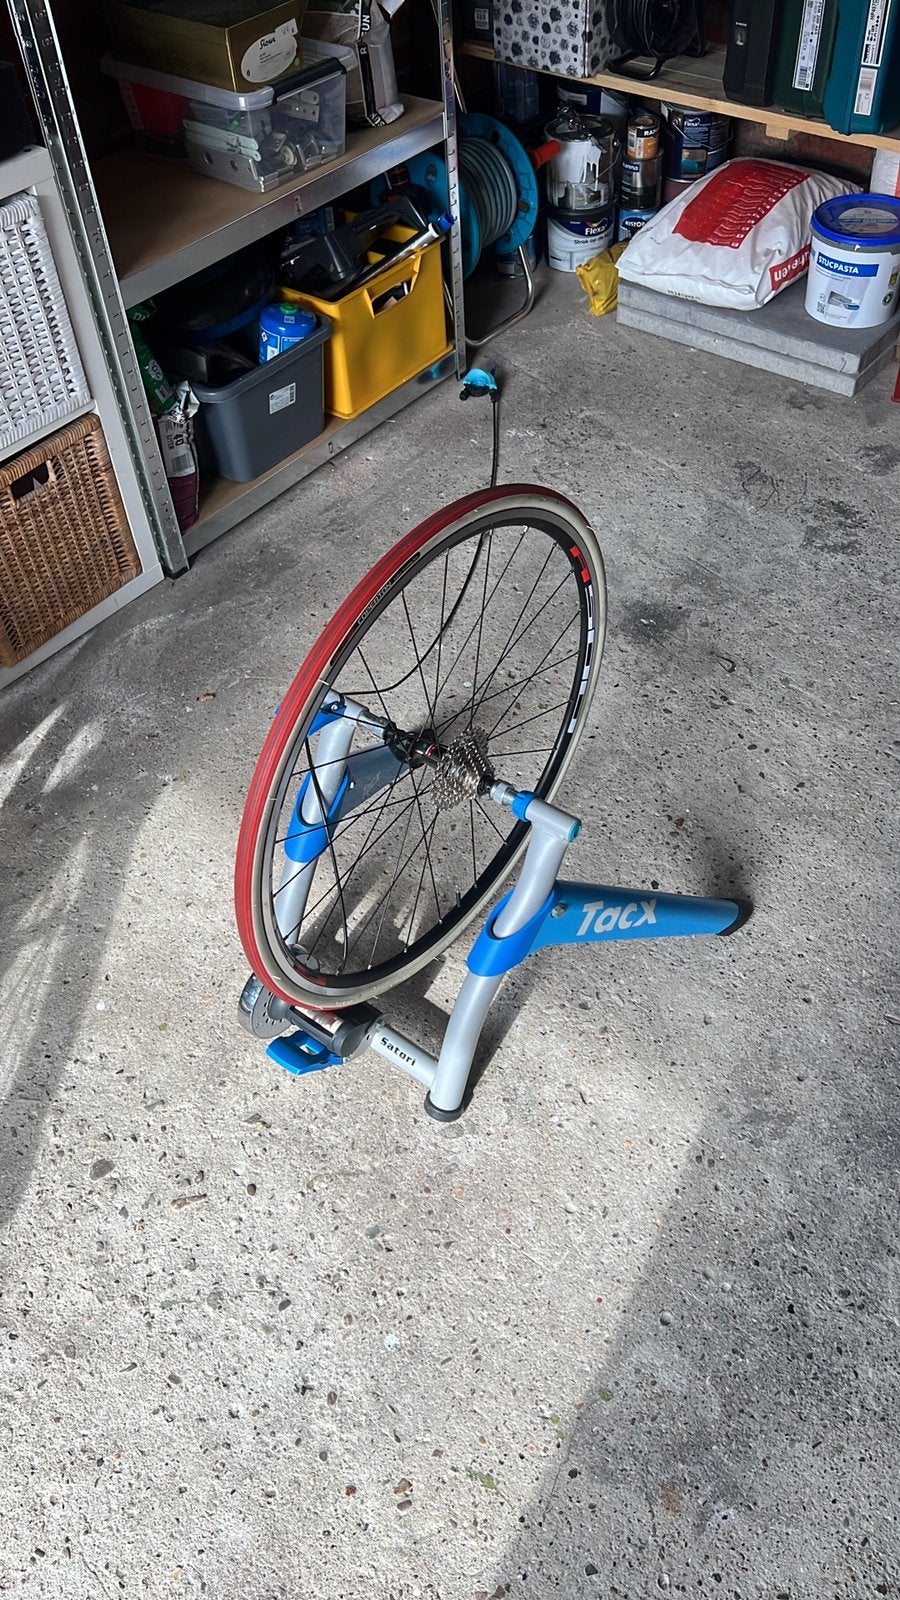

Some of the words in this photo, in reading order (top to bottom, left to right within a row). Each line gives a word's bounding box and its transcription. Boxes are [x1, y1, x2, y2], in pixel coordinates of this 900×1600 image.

[585, 226, 606, 236] Flexa
[819, 256, 859, 274] STUCPASTA
[576, 899, 657, 937] Tacx
[380, 1037, 416, 1066] Satori
